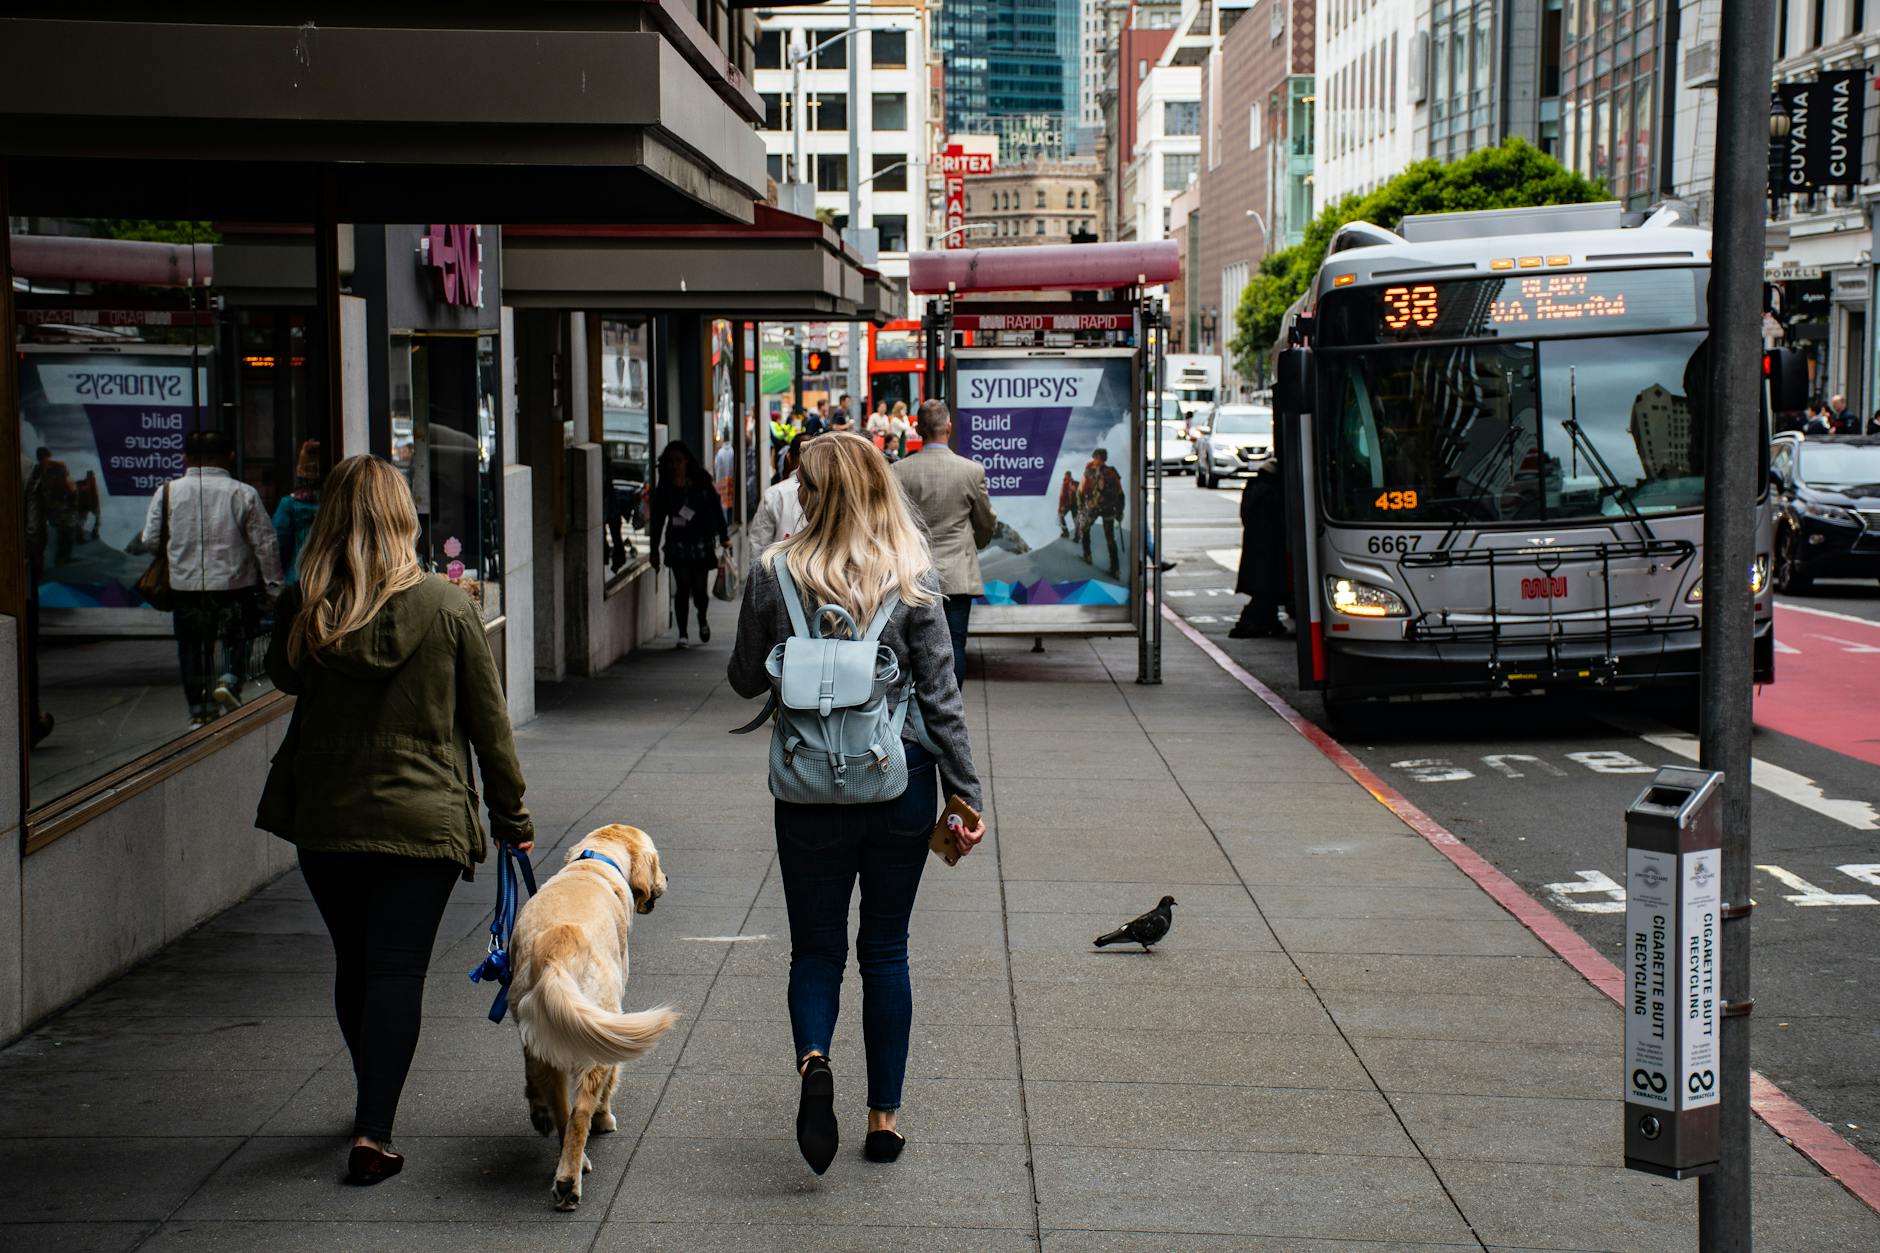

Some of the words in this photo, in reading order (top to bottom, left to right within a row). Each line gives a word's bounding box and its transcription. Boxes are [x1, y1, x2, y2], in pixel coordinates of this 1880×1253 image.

[1024, 114, 1050, 129] THE
[1830, 79, 1850, 177] CUYANA
[1009, 131, 1062, 146] PALACE
[1789, 91, 1809, 185] CUYANA
[1764, 269, 1819, 279] POWELL
[1384, 285, 1438, 329] 38
[1007, 316, 1044, 329] RAPID
[1080, 316, 1118, 329] RAPID
[971, 414, 1012, 432] Build
[971, 435, 1028, 451] Secure
[985, 475, 1023, 489] aster
[1375, 490, 1418, 511] 439
[1367, 535, 1422, 554] 6667
[1652, 915, 1665, 997] CIGARETTE
[1703, 913, 1713, 995] CIGARETTE
[1635, 932, 1647, 1016] RECYCLING
[1690, 936, 1699, 1019] RECYCLING
[1652, 1001, 1665, 1040] BUTT
[1703, 999, 1713, 1037] BUTT
